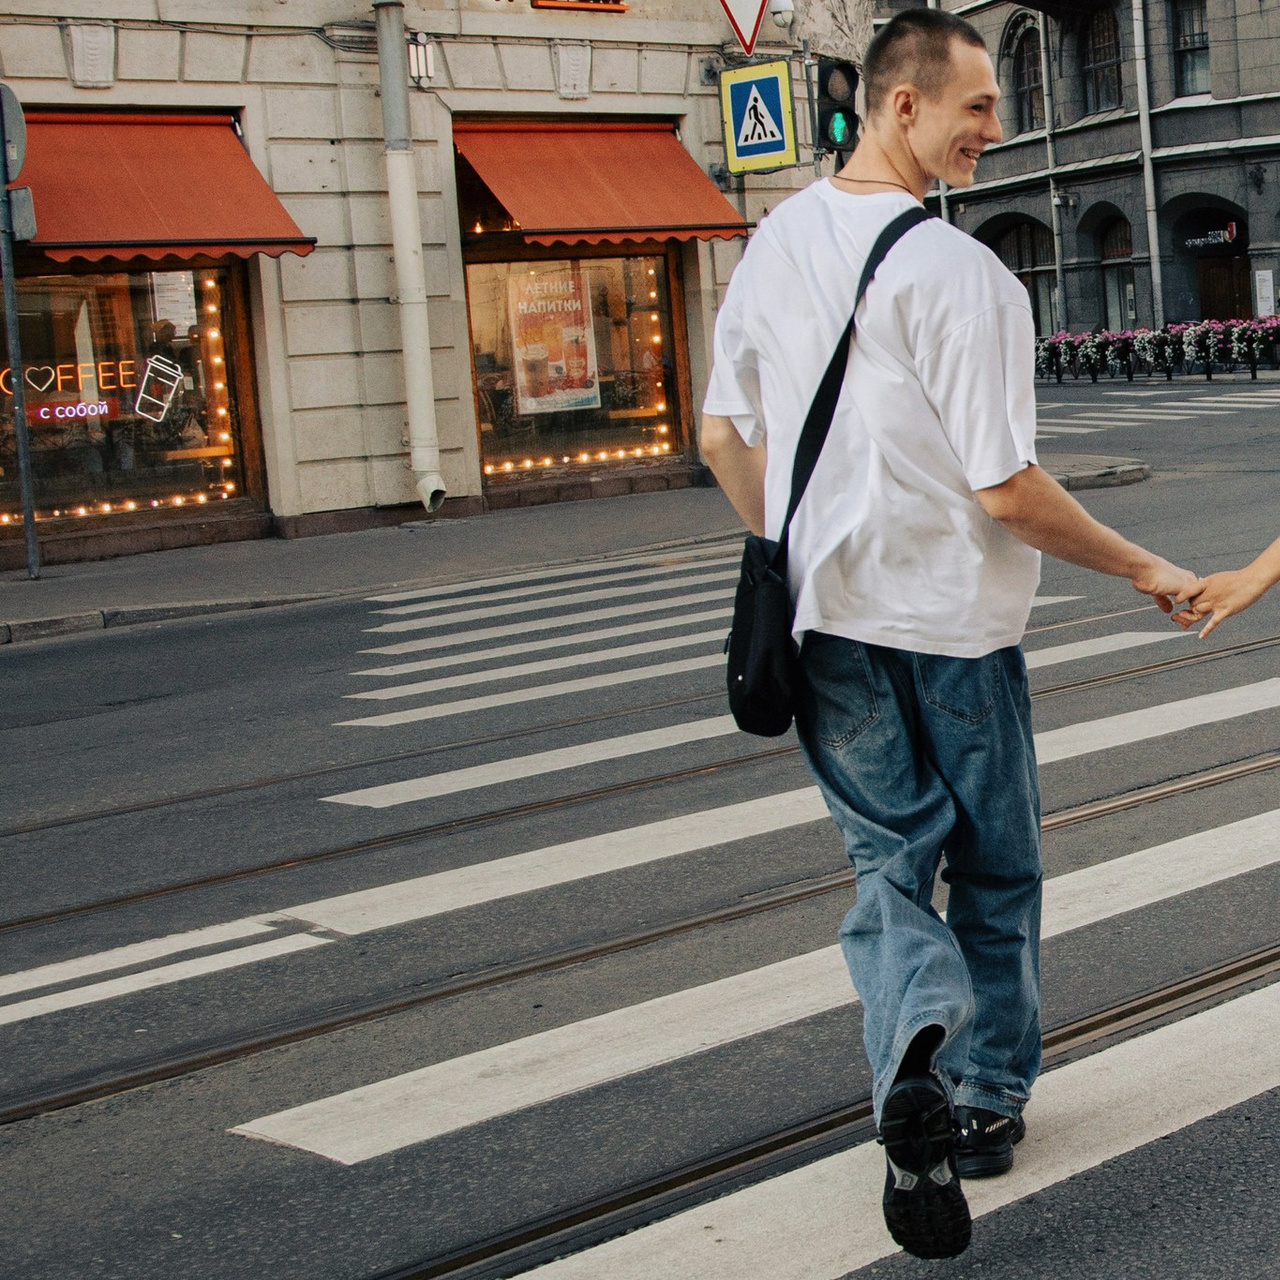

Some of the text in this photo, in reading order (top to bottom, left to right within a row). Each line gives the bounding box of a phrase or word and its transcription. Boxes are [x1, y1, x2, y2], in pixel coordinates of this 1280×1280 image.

[525, 280, 576, 295] ЛЕТНИЕ
[518, 298, 582, 314] НАПИТКИ
[55, 401, 109, 418] собой
